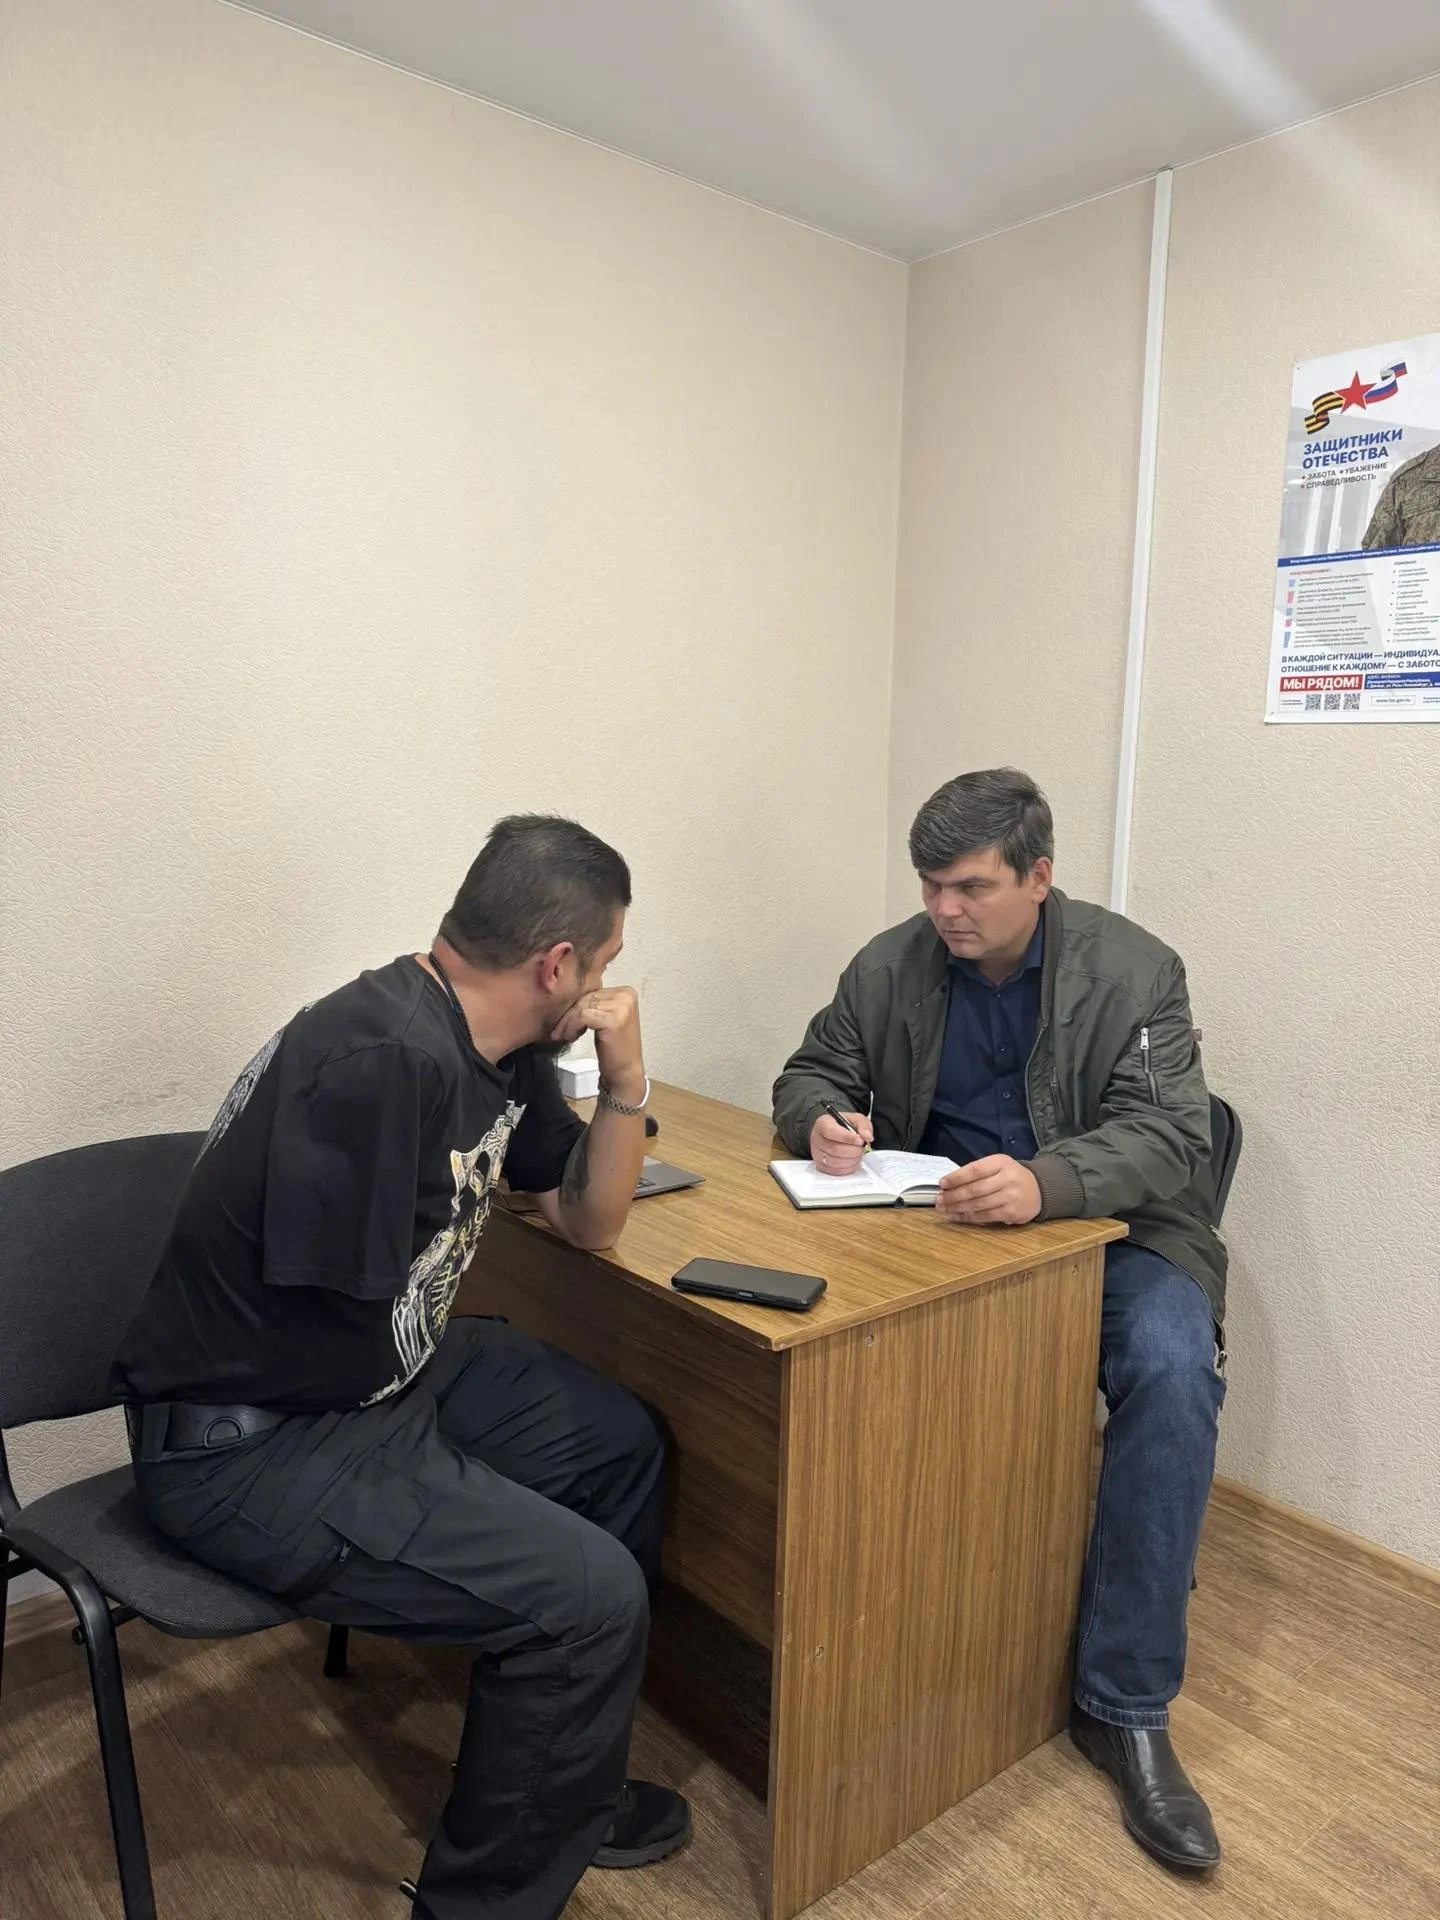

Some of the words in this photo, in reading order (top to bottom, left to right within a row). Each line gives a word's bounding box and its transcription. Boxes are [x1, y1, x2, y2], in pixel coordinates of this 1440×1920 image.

[1303, 428, 1403, 455] ЗАЩИТНИКИ
[1302, 446, 1389, 469] ОТЕЧЕСТВА
[1307, 470, 1336, 480] ЗАБОТА
[1344, 462, 1389, 474] УВАЖЕНИЕ
[1306, 473, 1376, 489] СПРАВЕДЛИВОСТЬ
[1288, 652, 1326, 663] КАЖДОЙ
[1327, 652, 1373, 661] СИТУАЦИИ
[1384, 649, 1440, 659] ИНДИВИДУА
[1281, 664, 1331, 673] ОТНОШЕНИЕ
[1340, 662, 1387, 671] КАЖДОМУ
[1283, 678, 1306, 690] МЫ
[1307, 676, 1360, 691] РЯДОМ!
